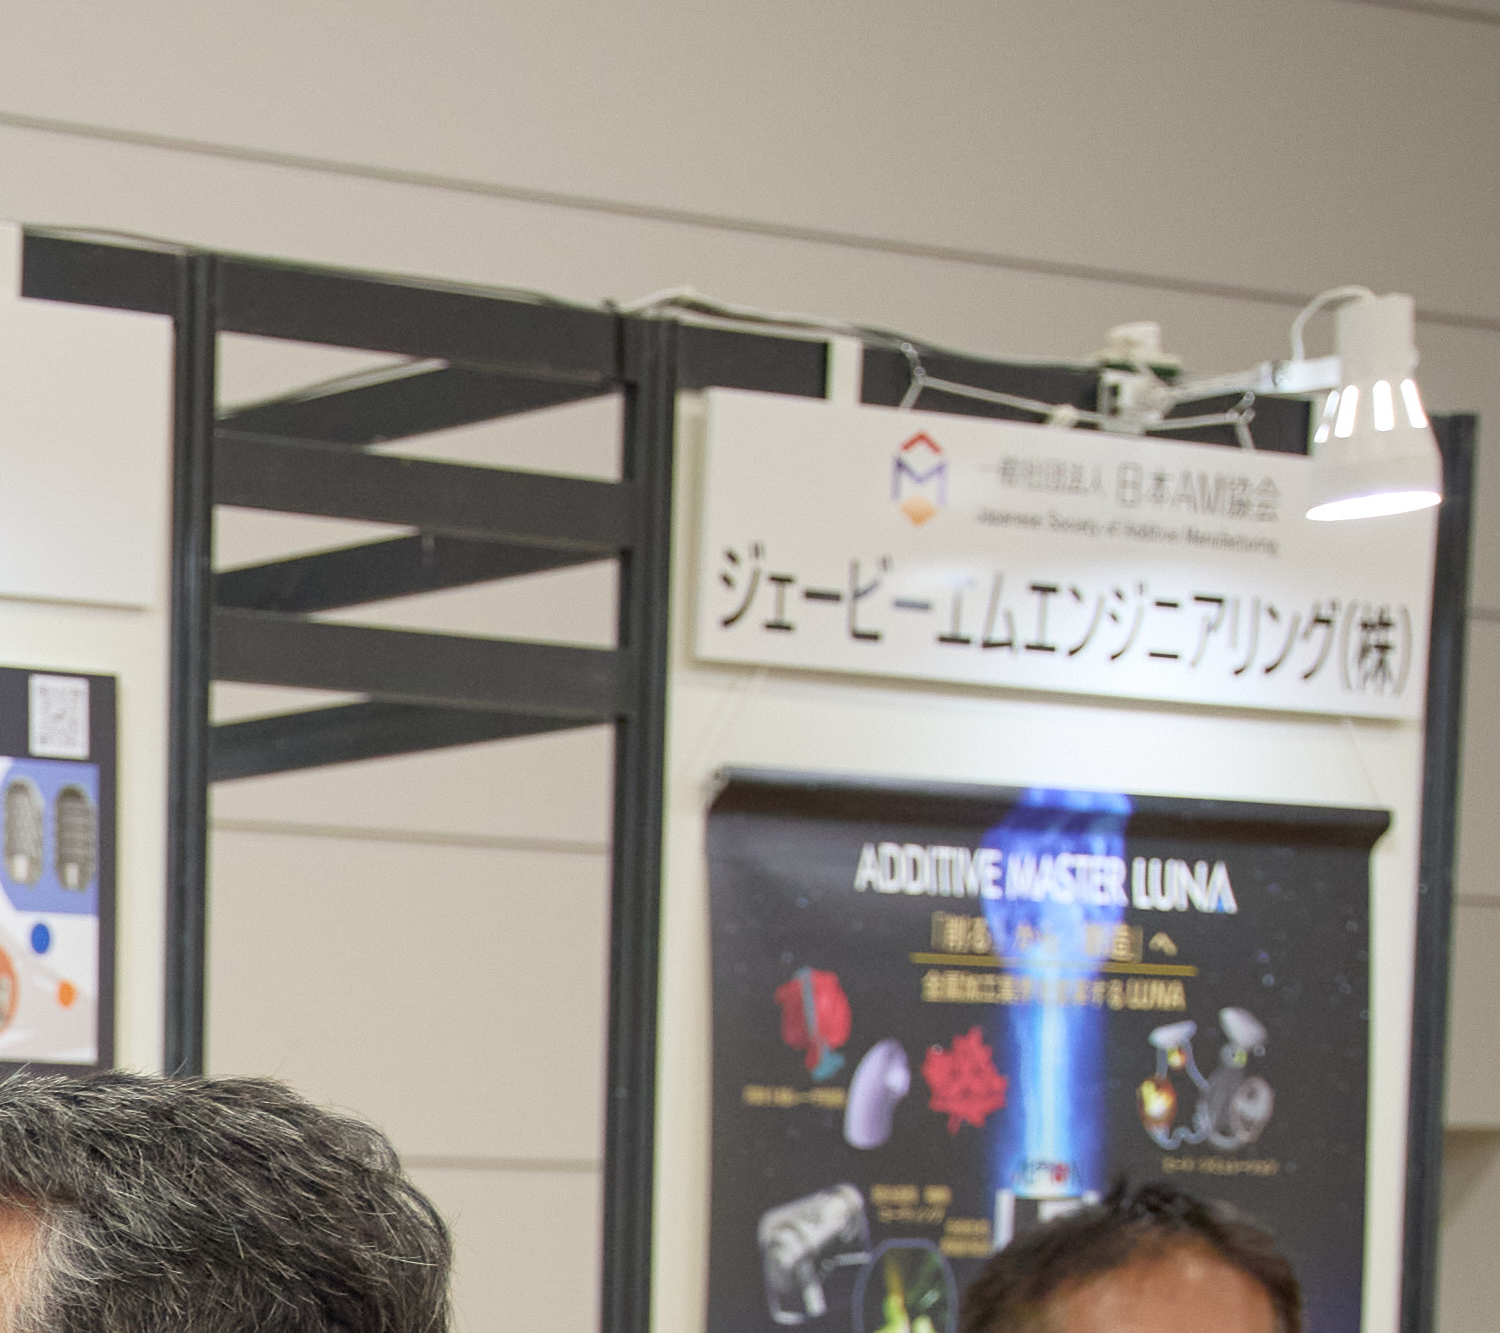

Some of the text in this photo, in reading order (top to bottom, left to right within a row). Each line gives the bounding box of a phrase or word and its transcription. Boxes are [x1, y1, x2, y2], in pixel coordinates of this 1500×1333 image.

[853, 840, 1238, 915] ADDITIVE MASTER LUNA
